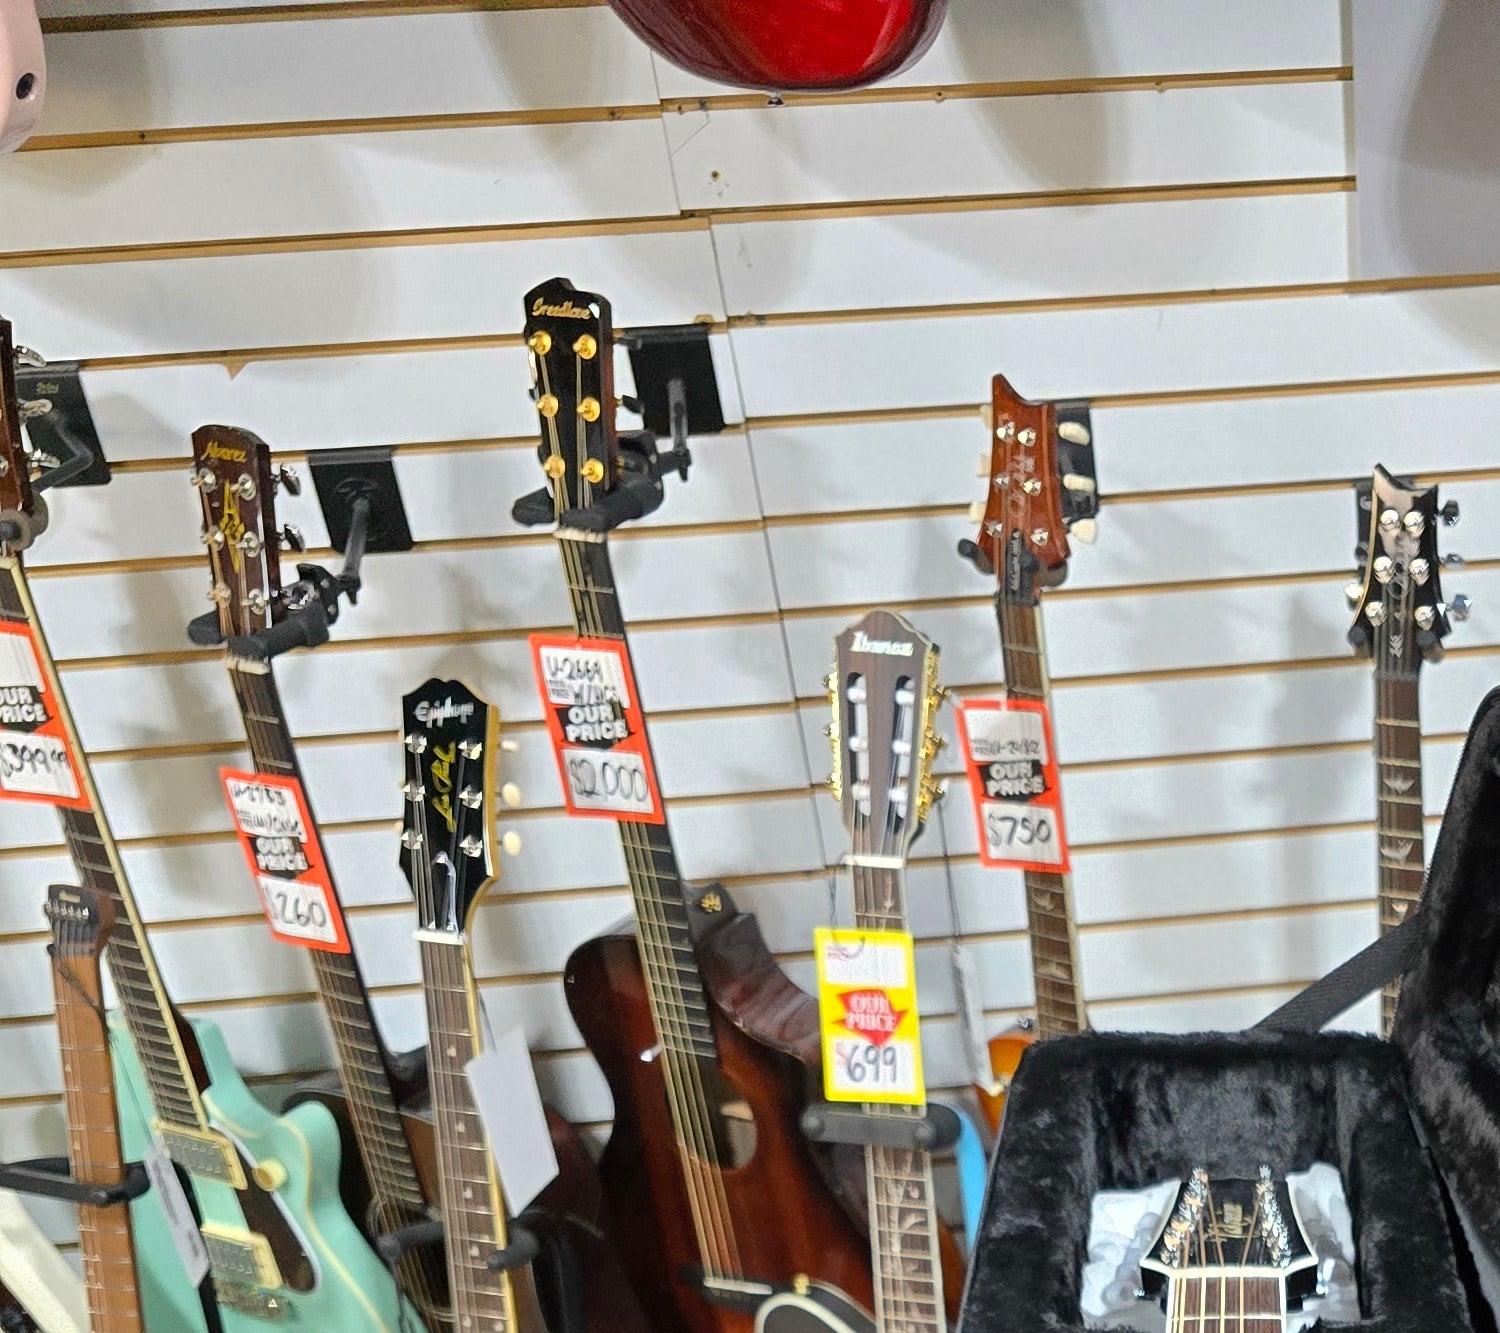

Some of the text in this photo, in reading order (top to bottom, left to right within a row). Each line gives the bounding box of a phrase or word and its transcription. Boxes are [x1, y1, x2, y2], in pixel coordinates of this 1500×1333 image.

[567, 703, 614, 726] OUR
[565, 720, 629, 743] PRICE
[989, 761, 1033, 780] OUR
[986, 775, 1045, 797] PRICE
[987, 813, 1051, 847] $750
[255, 837, 295, 855] OUR
[257, 852, 309, 872] PRICE
[849, 993, 891, 1014] OUR
[844, 1012, 898, 1033] PRICE
